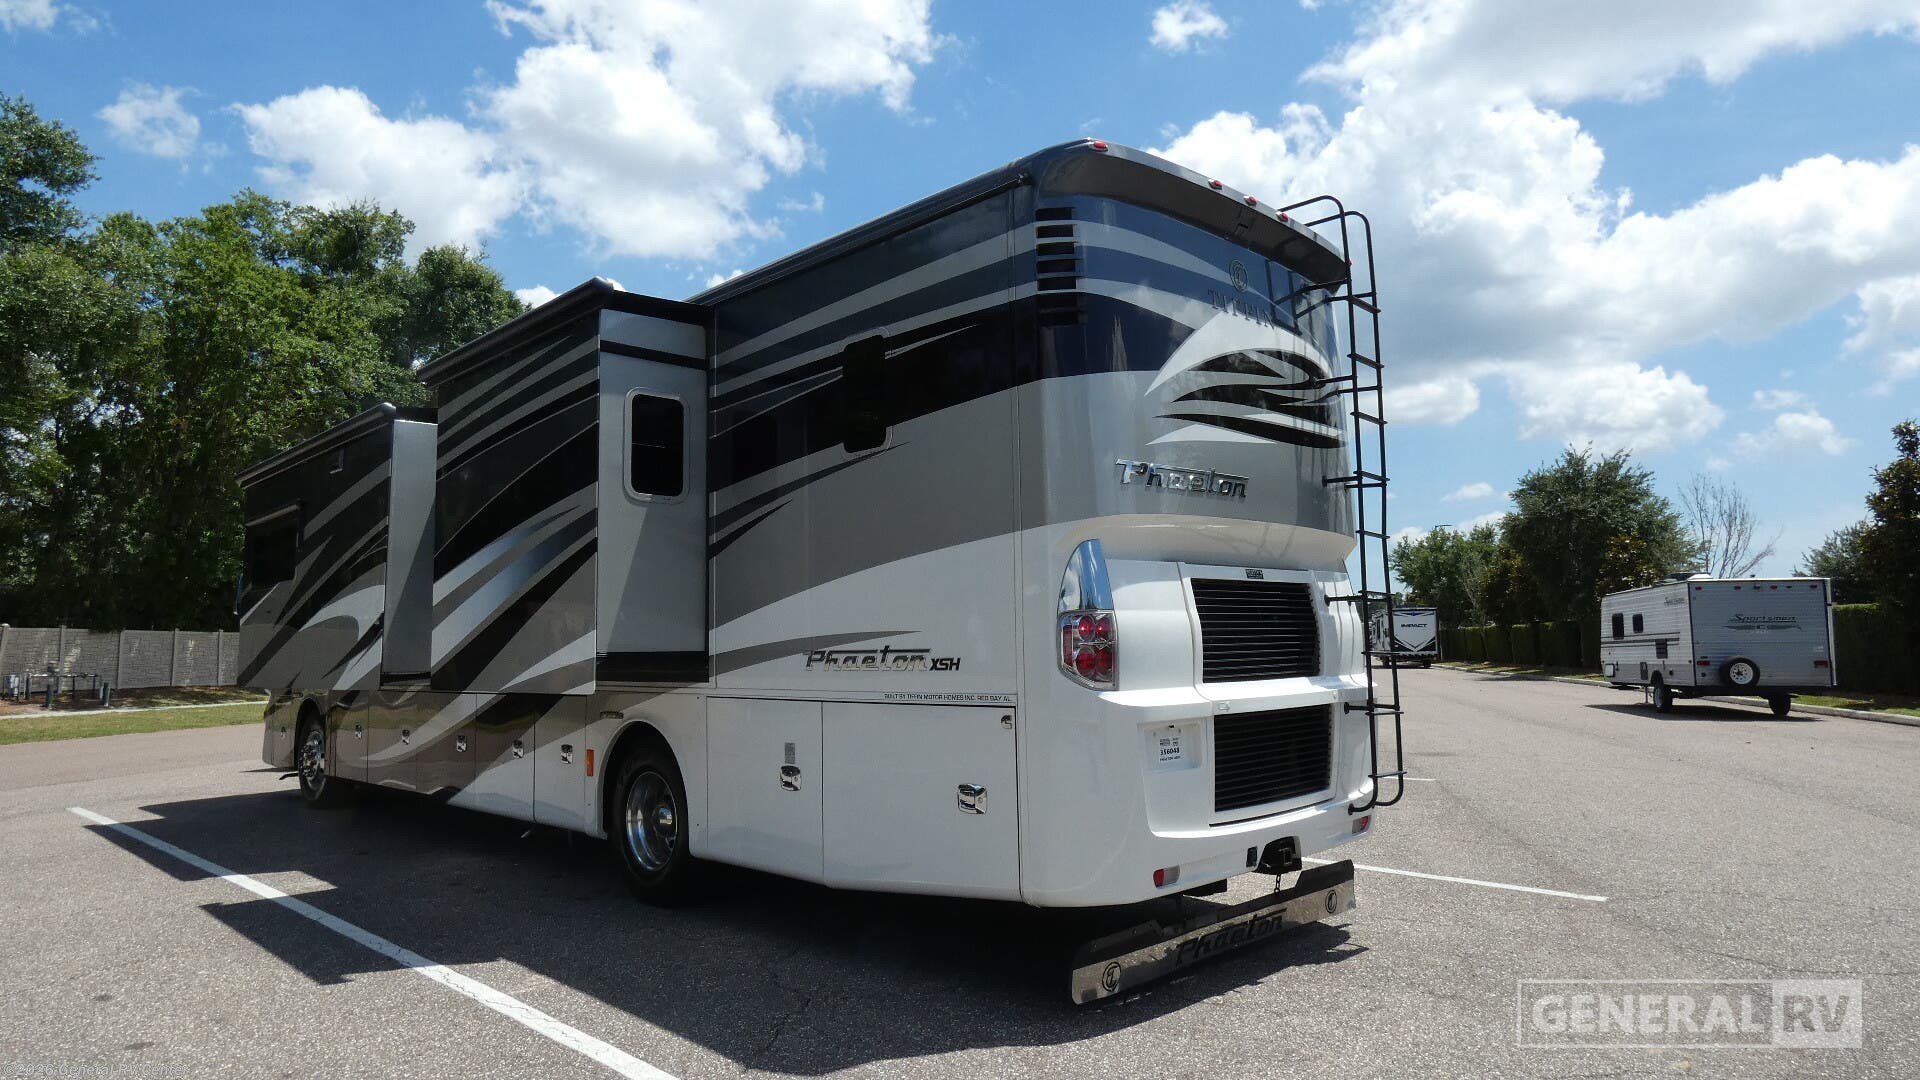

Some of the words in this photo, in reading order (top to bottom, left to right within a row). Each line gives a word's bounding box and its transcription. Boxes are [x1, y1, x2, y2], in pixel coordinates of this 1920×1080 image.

[1115, 457, 1250, 499] Phaeton
[803, 645, 931, 672] Phaeton
[929, 657, 961, 671] XSH
